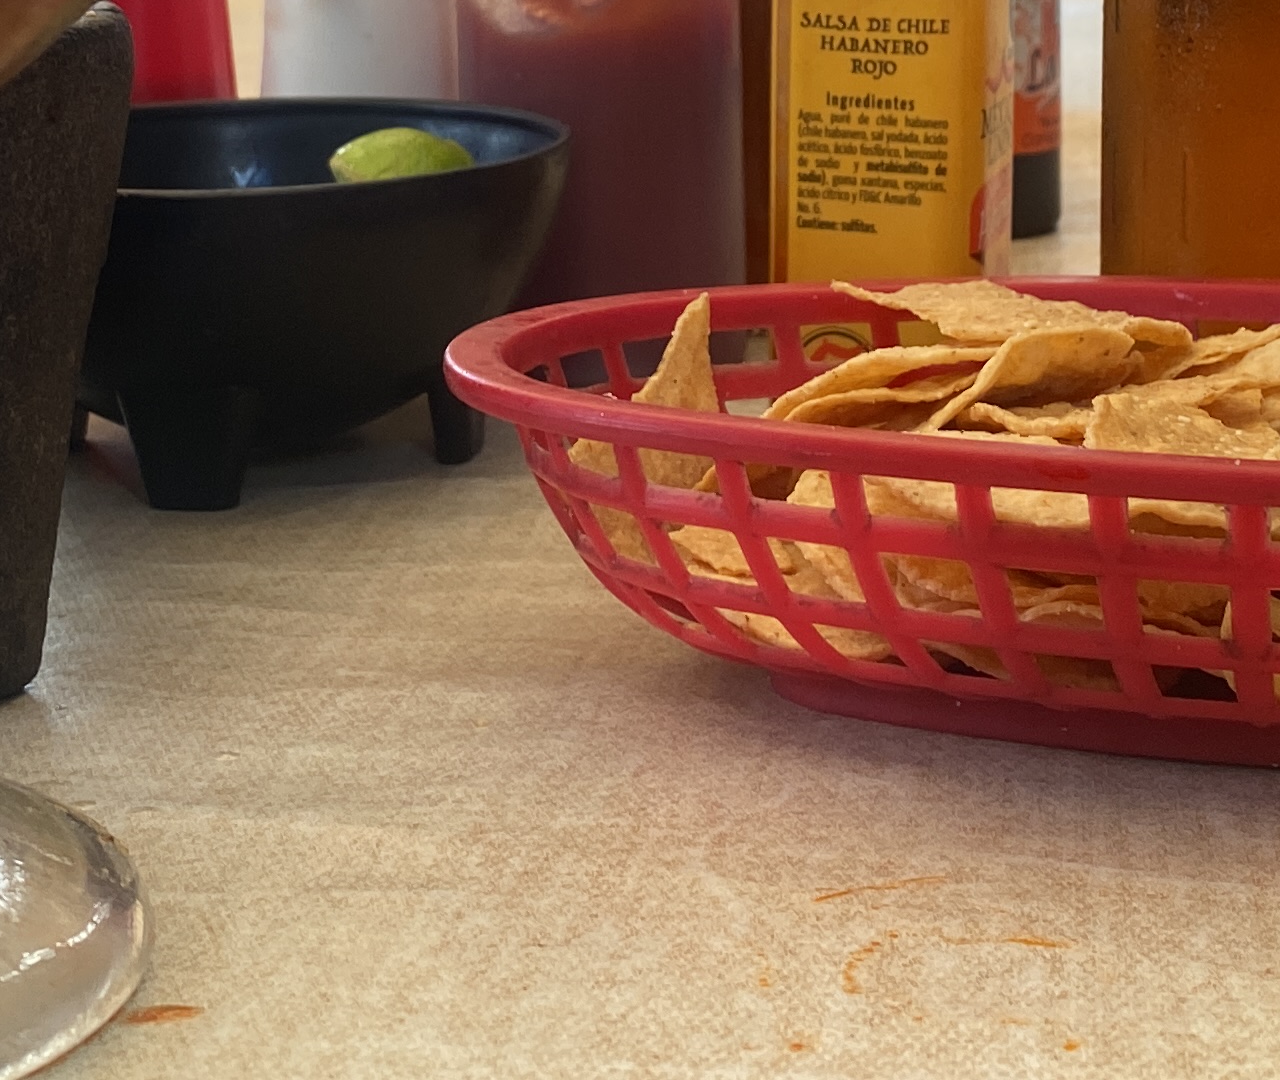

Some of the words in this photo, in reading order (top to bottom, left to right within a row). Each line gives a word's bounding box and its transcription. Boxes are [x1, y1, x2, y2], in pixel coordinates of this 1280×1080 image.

[800, 11, 860, 32] SALSA
[866, 17, 892, 33] DE
[897, 18, 950, 35] CHILE
[820, 35, 929, 56] HABANERO
[851, 58, 898, 80] ROJO
[826, 91, 915, 112] Ingredientes
